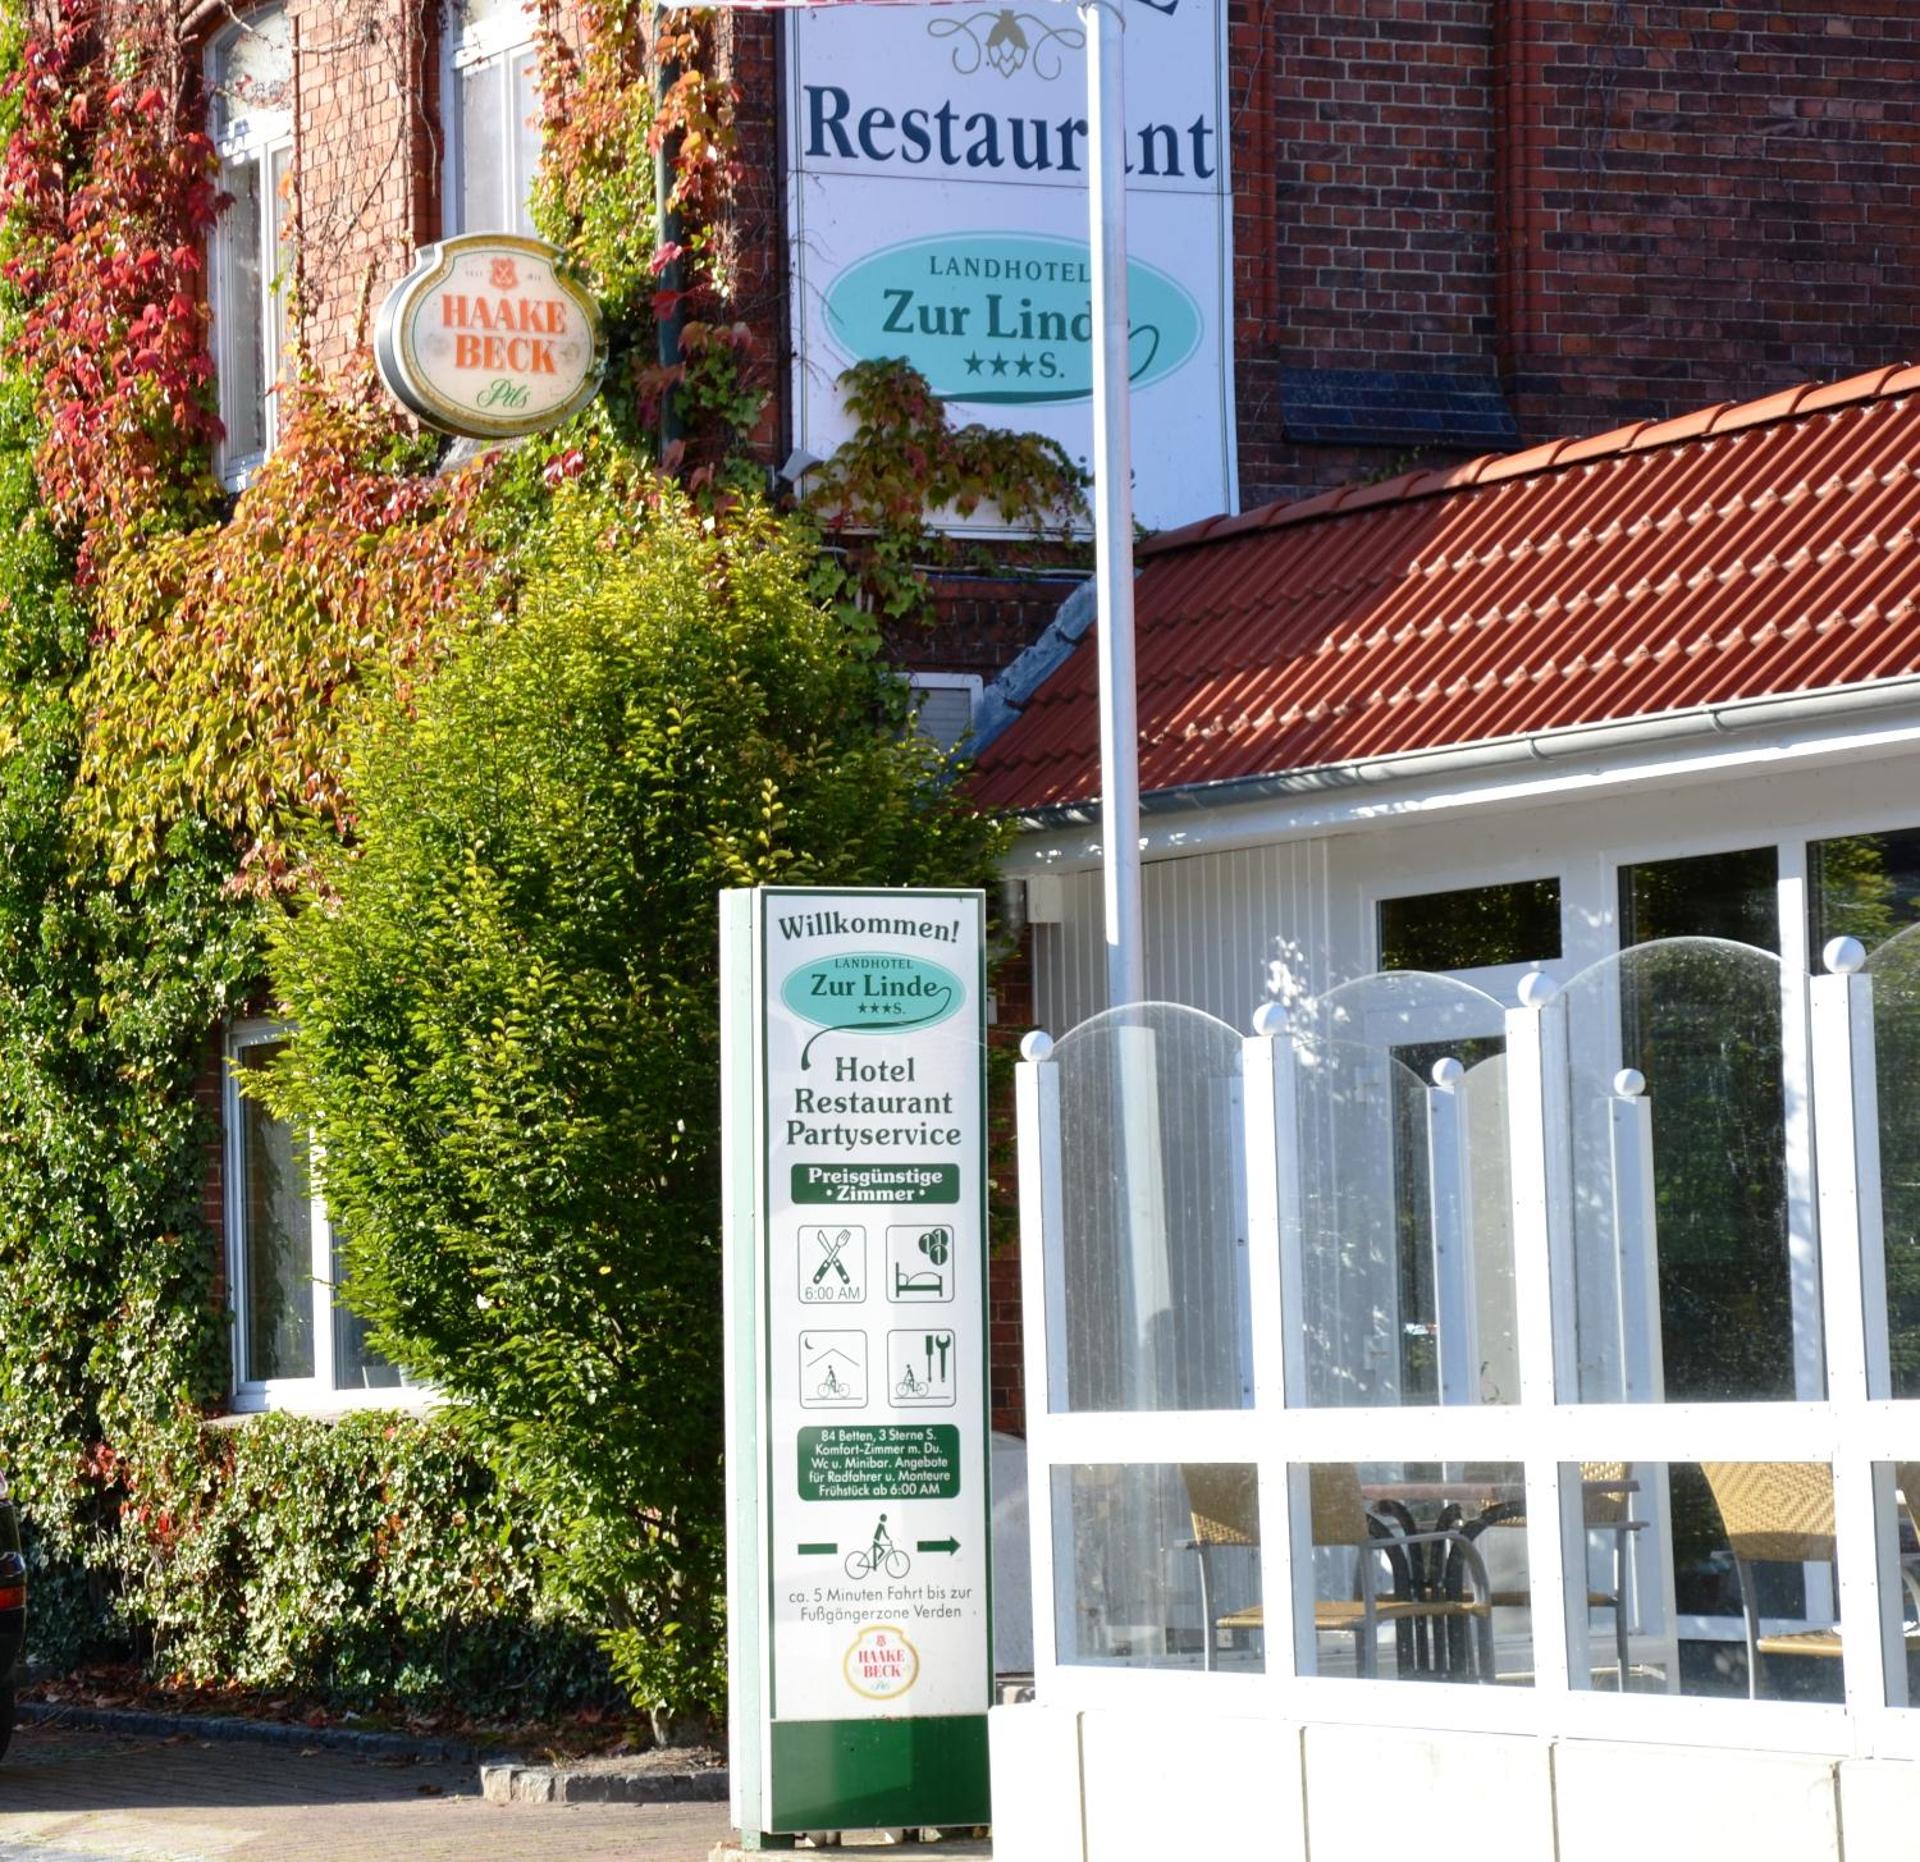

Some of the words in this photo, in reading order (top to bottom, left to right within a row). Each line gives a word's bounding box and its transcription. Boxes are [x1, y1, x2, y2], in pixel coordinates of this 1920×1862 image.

[803, 84, 1216, 179] Restaurnt
[929, 255, 1092, 283] LANDHOTEL
[442, 293, 567, 336] HAAKE
[882, 288, 970, 336] Zur
[455, 333, 557, 376] BECK
[477, 378, 531, 409] Pils
[778, 911, 960, 943] Willkommen!
[835, 958, 914, 969] LANDHOTEL
[810, 974, 856, 997] Zur
[864, 974, 940, 997] Linde
[834, 1057, 916, 1082] Hotel
[794, 1088, 953, 1114] Restaurant
[786, 1120, 962, 1151] Partyservice
[808, 1167, 943, 1187] Preisgünstige
[836, 1185, 915, 1202] Zimmer
[804, 1286, 834, 1300] 6:00
[838, 1286, 861, 1300] AM
[821, 1429, 836, 1442] 84
[839, 1429, 876, 1443] Betten,
[878, 1429, 887, 1441] 3
[889, 1428, 924, 1441] Sterne
[926, 1428, 937, 1441] S.
[815, 1442, 906, 1456] Komfort-Zimmer
[908, 1445, 921, 1454] m.
[924, 1441, 943, 1454] Du.
[811, 1457, 829, 1469] Wc
[832, 1459, 842, 1469] u.
[845, 1456, 892, 1469] Minibar.
[895, 1456, 948, 1471] Angebote
[809, 1471, 825, 1483] für
[828, 1471, 882, 1483] Radfahrer
[885, 1473, 895, 1482] u.
[898, 1470, 951, 1482] Monteure
[819, 1484, 870, 1497] Frühstück
[873, 1484, 888, 1496] ab
[890, 1483, 917, 1496] 6:00
[920, 1483, 940, 1495] AM
[789, 1592, 810, 1603] ca.
[814, 1588, 822, 1602] 5
[827, 1588, 883, 1602] Minuten
[888, 1586, 923, 1600] Fahrt
[928, 1587, 946, 1600] bis
[951, 1588, 973, 1599] zur
[800, 1606, 909, 1624] Fußgängerzone
[914, 1605, 961, 1618] Verden
[859, 1650, 904, 1662] HAAKE
[864, 1665, 900, 1678] BECK
